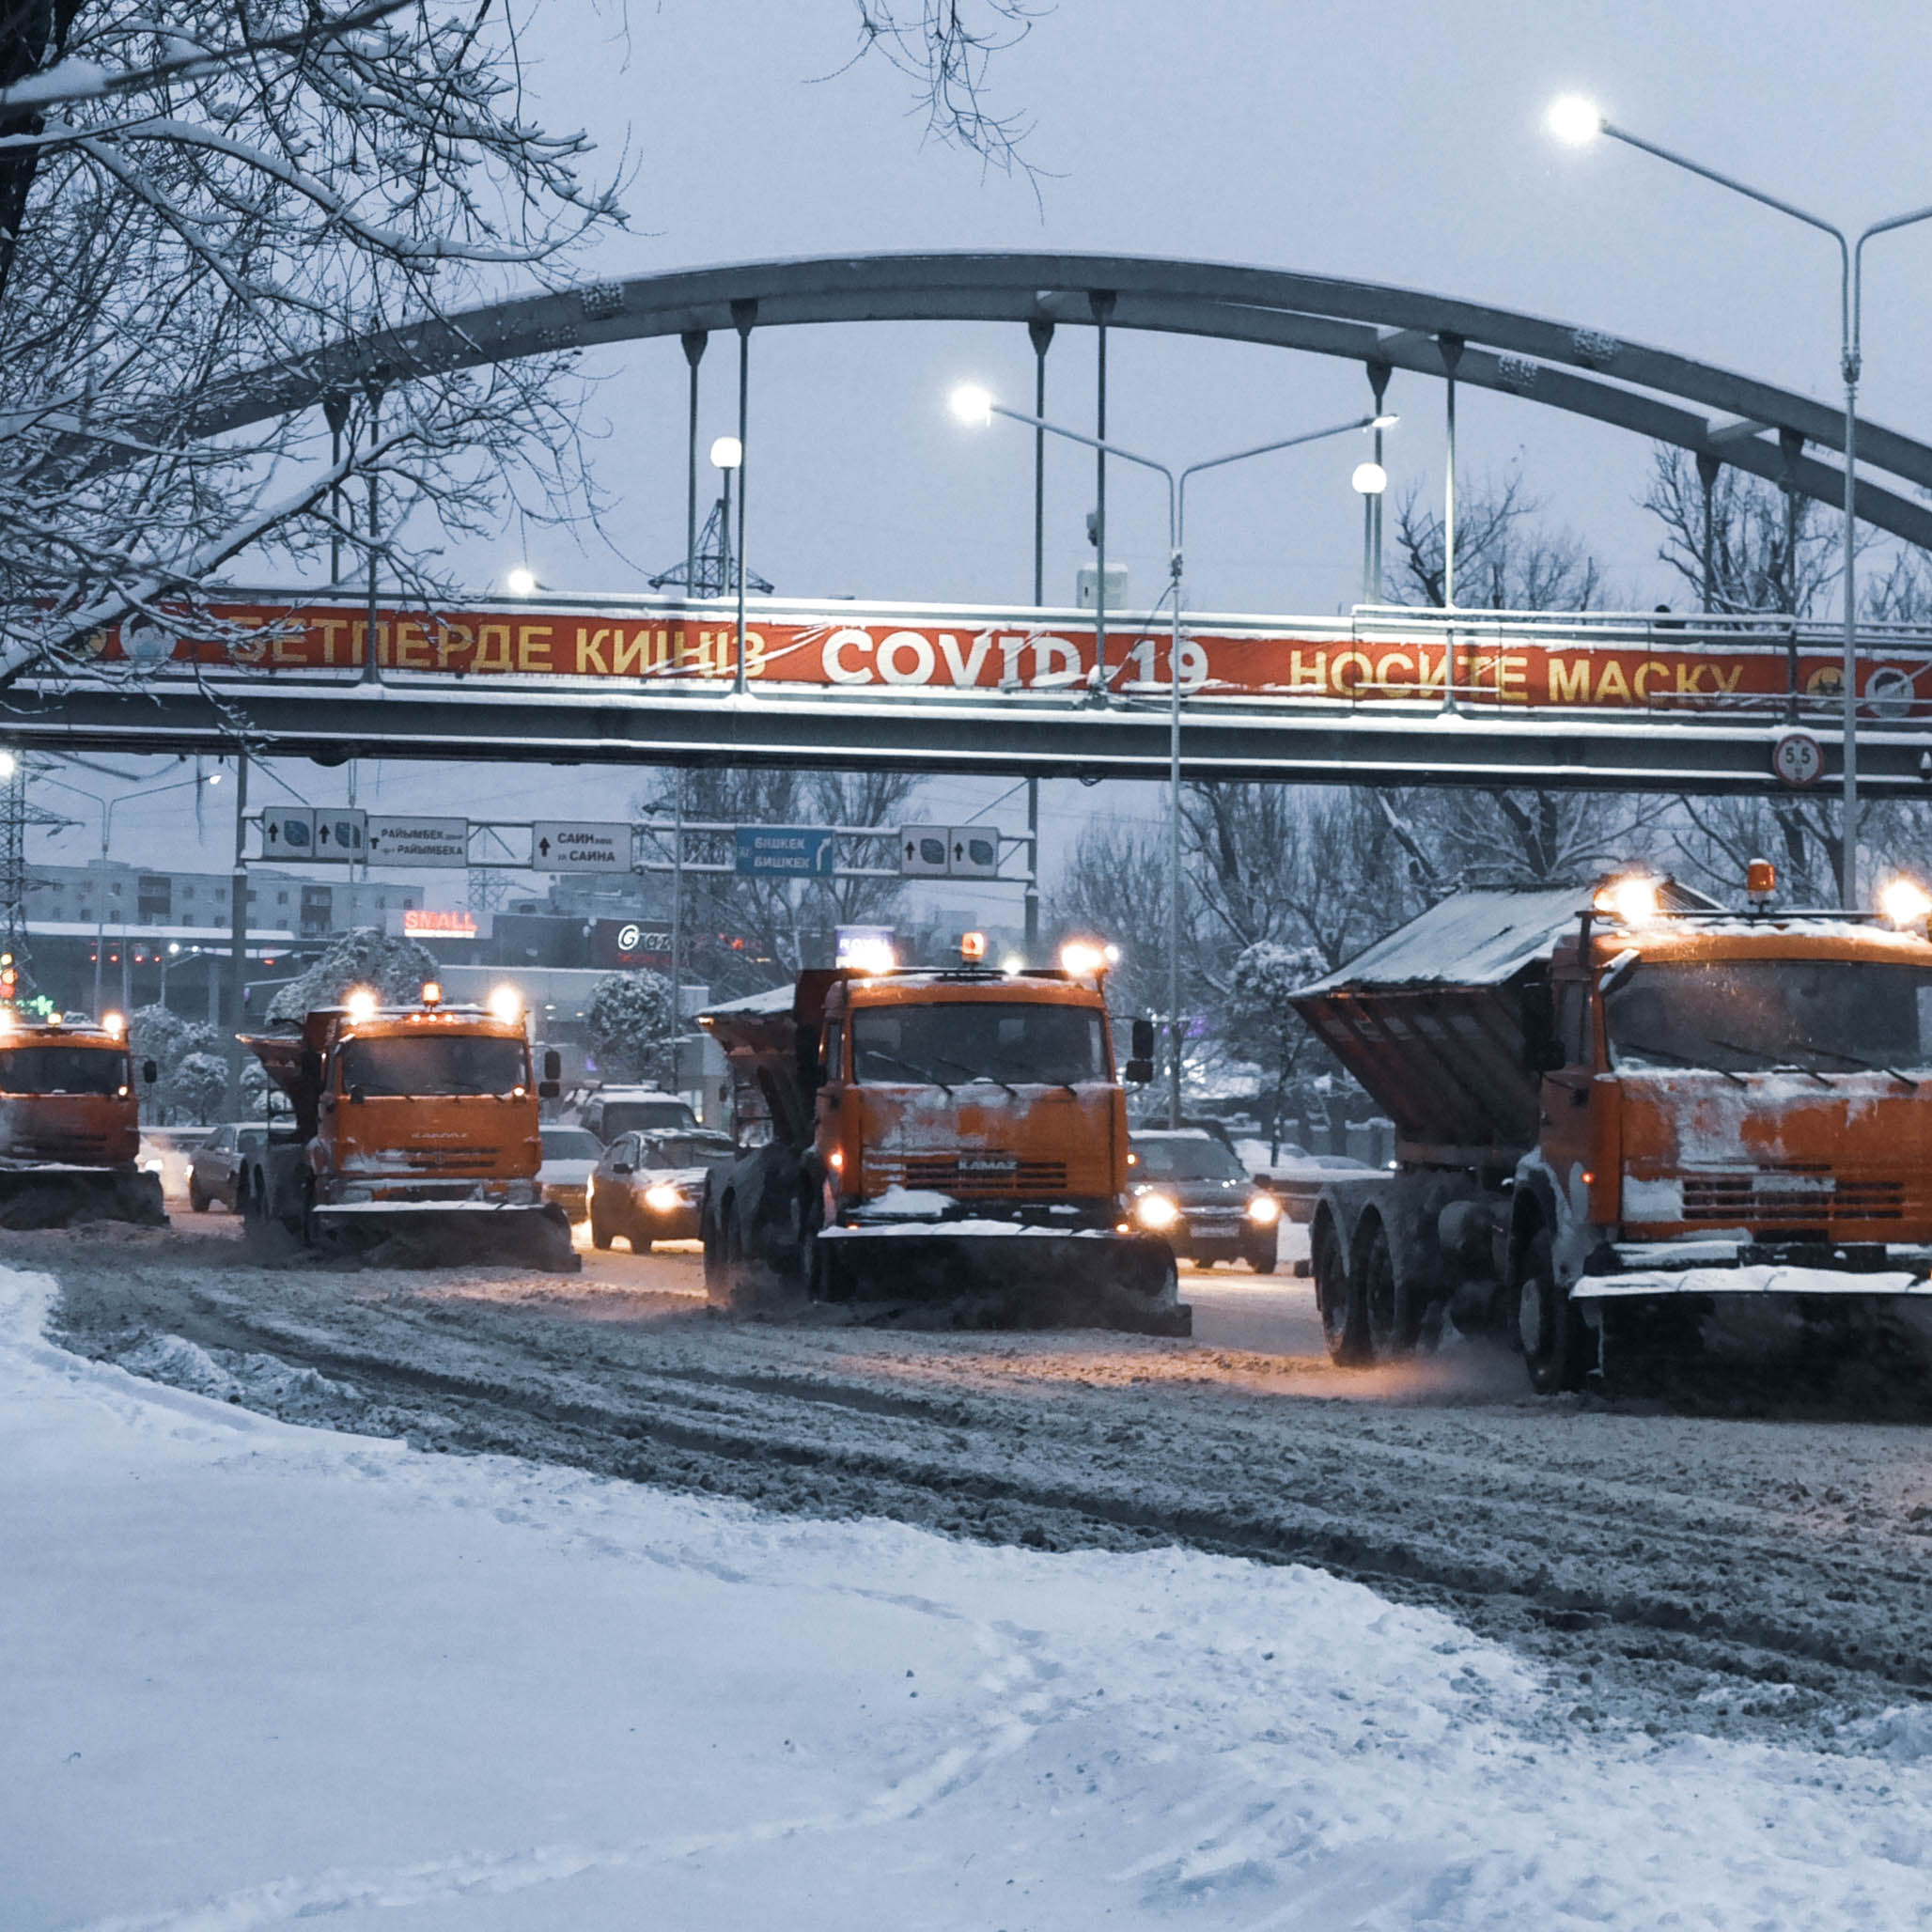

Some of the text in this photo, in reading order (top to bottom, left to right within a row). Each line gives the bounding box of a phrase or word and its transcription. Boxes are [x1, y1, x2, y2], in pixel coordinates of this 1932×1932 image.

[227, 615, 554, 673] БЕТПЕРДЕ
[821, 629, 1209, 694] COVID-19
[1290, 649, 1528, 700] НОСИТЕ
[1548, 658, 1744, 706] МАСКУ
[557, 833, 594, 844] САИН
[569, 850, 615, 862] САИНА
[754, 856, 811, 869] БИШКЕК
[405, 910, 477, 930] SMALL
